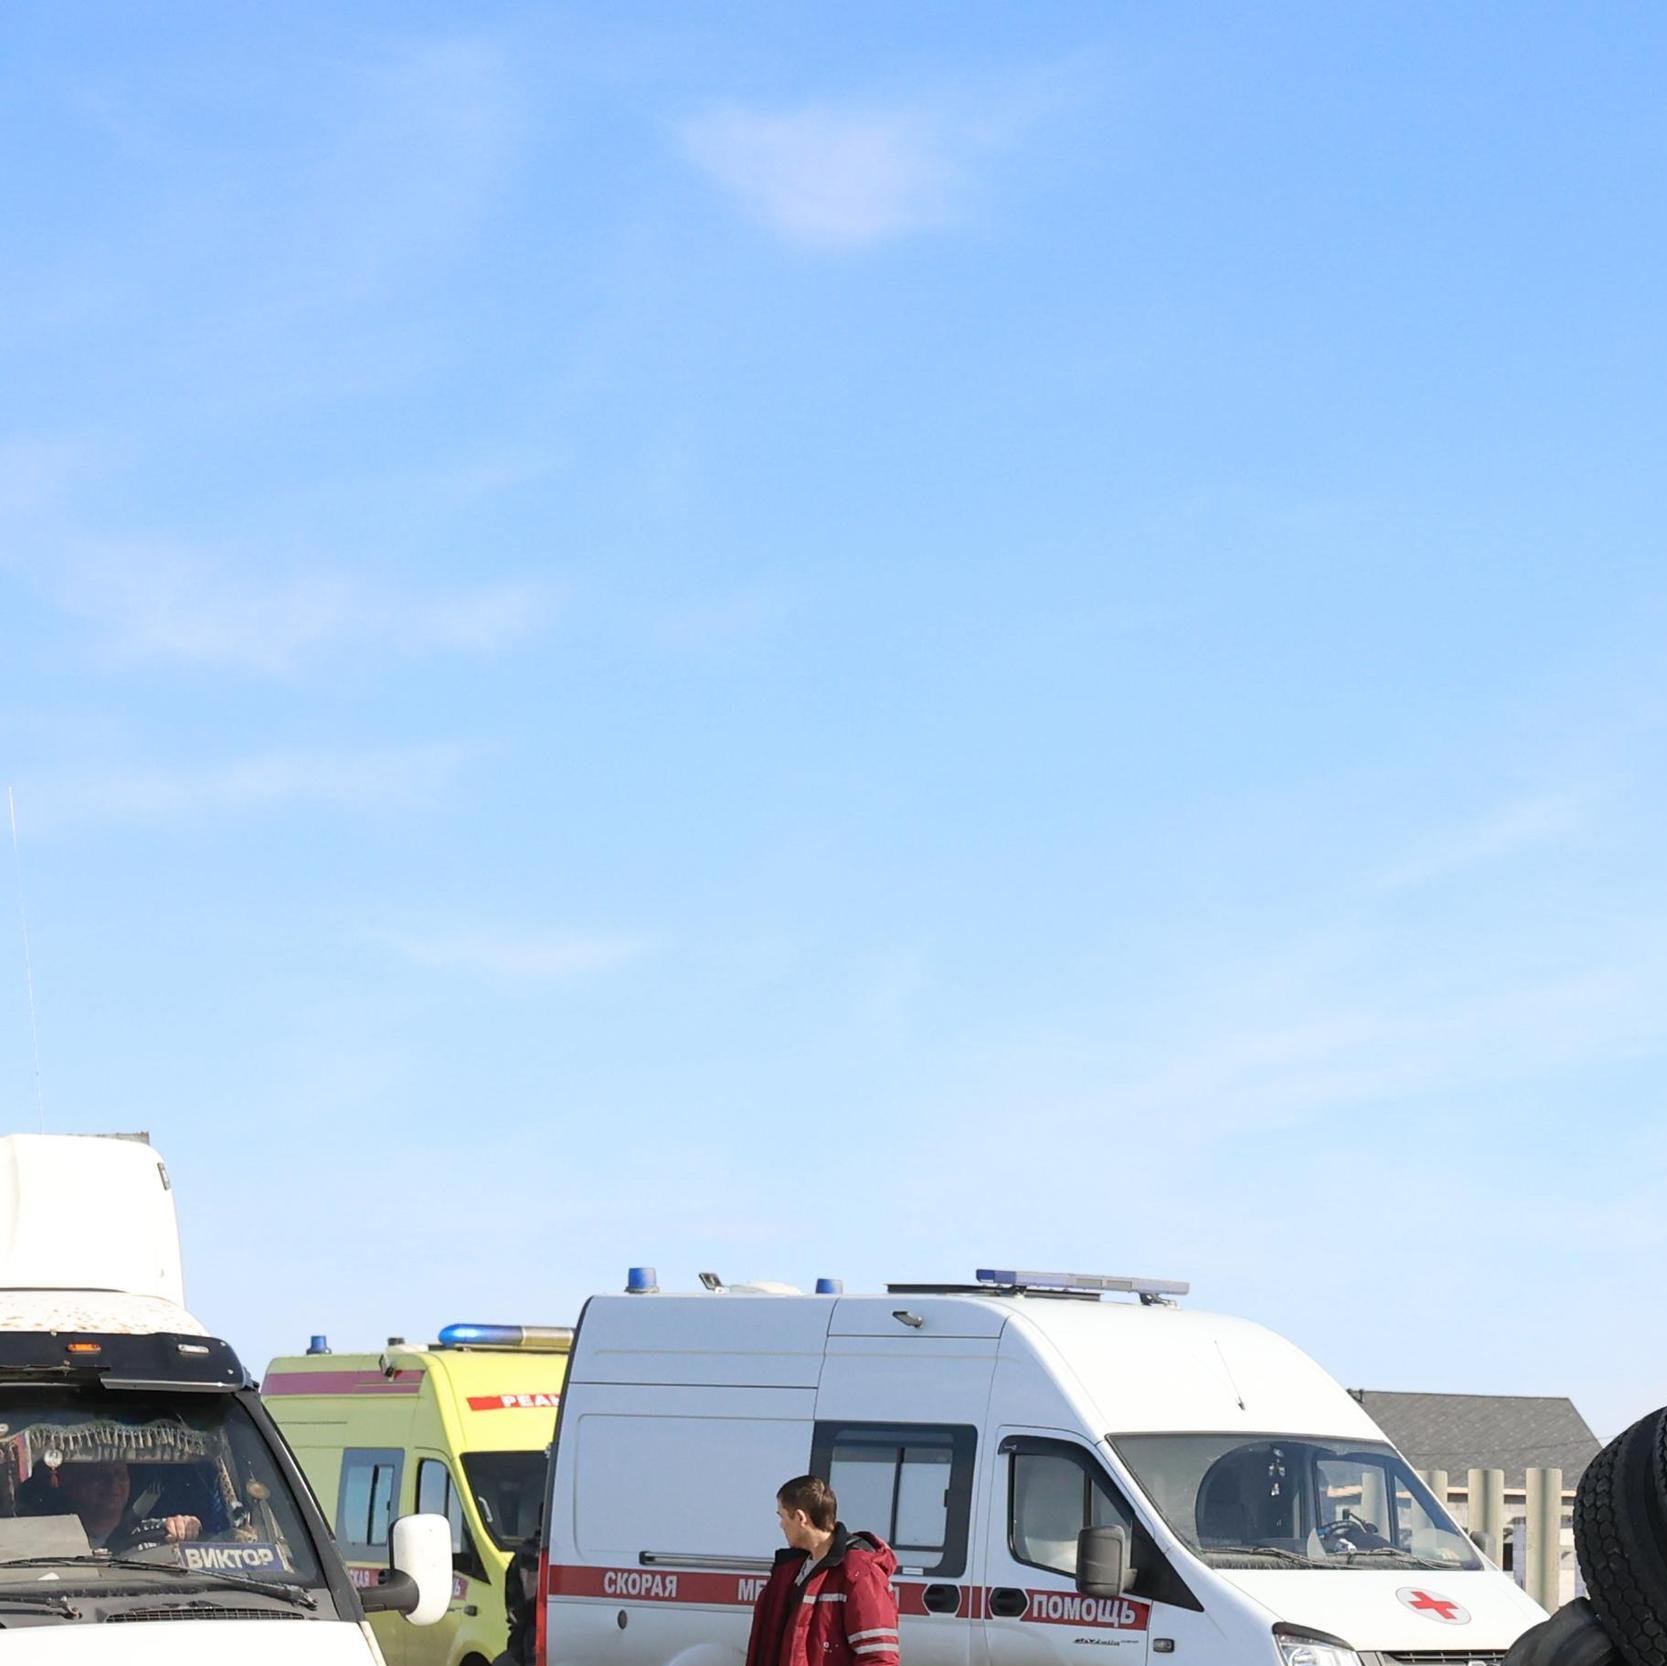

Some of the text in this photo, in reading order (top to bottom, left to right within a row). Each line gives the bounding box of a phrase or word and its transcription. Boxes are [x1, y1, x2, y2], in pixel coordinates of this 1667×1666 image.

[185, 1547, 275, 1569] ВИКТОР
[603, 1571, 1136, 1628] СКОРАЯ ПОМОЩЬ
